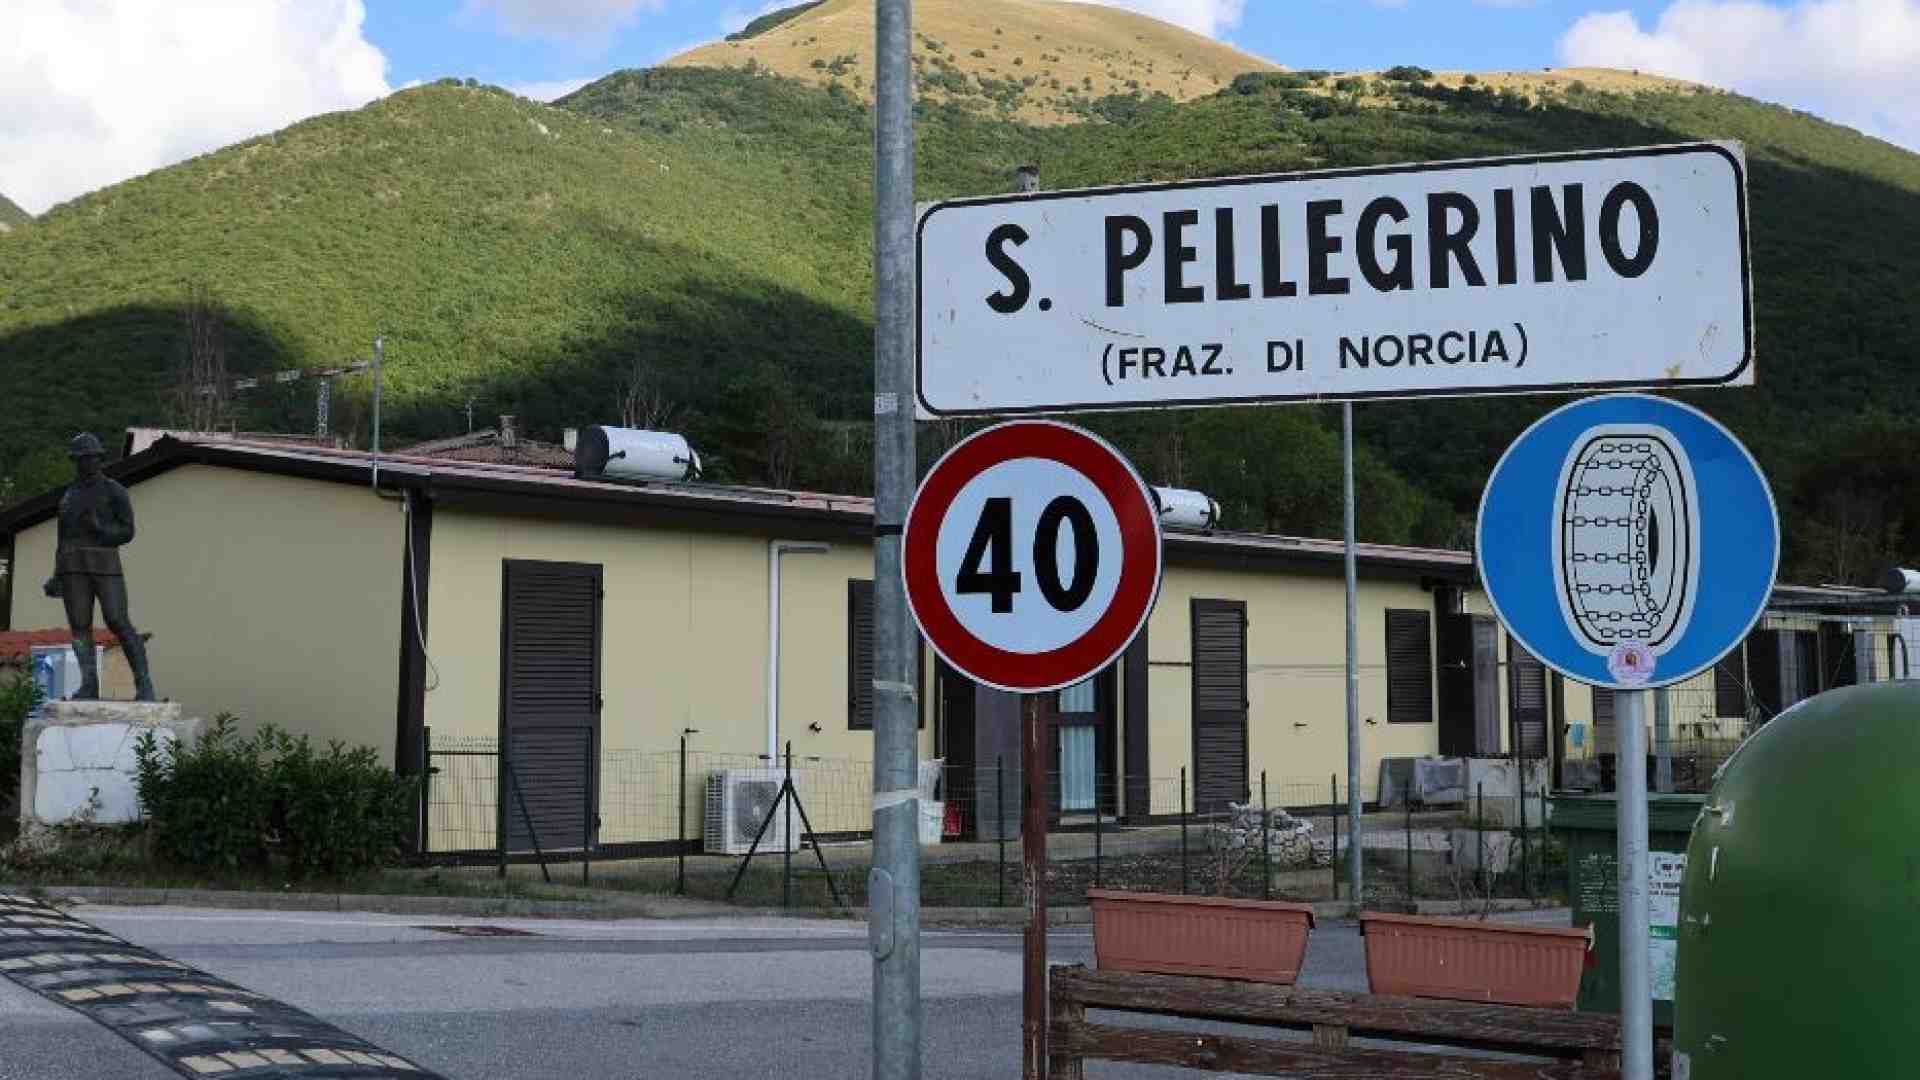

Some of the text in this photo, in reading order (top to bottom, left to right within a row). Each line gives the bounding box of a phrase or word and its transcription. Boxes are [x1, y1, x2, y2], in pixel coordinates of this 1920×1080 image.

[985, 180, 1661, 314] S. PELLEGRINO
[1101, 322, 1529, 387] (FRAZ. DI NORCIA)
[955, 495, 1100, 614] 40
